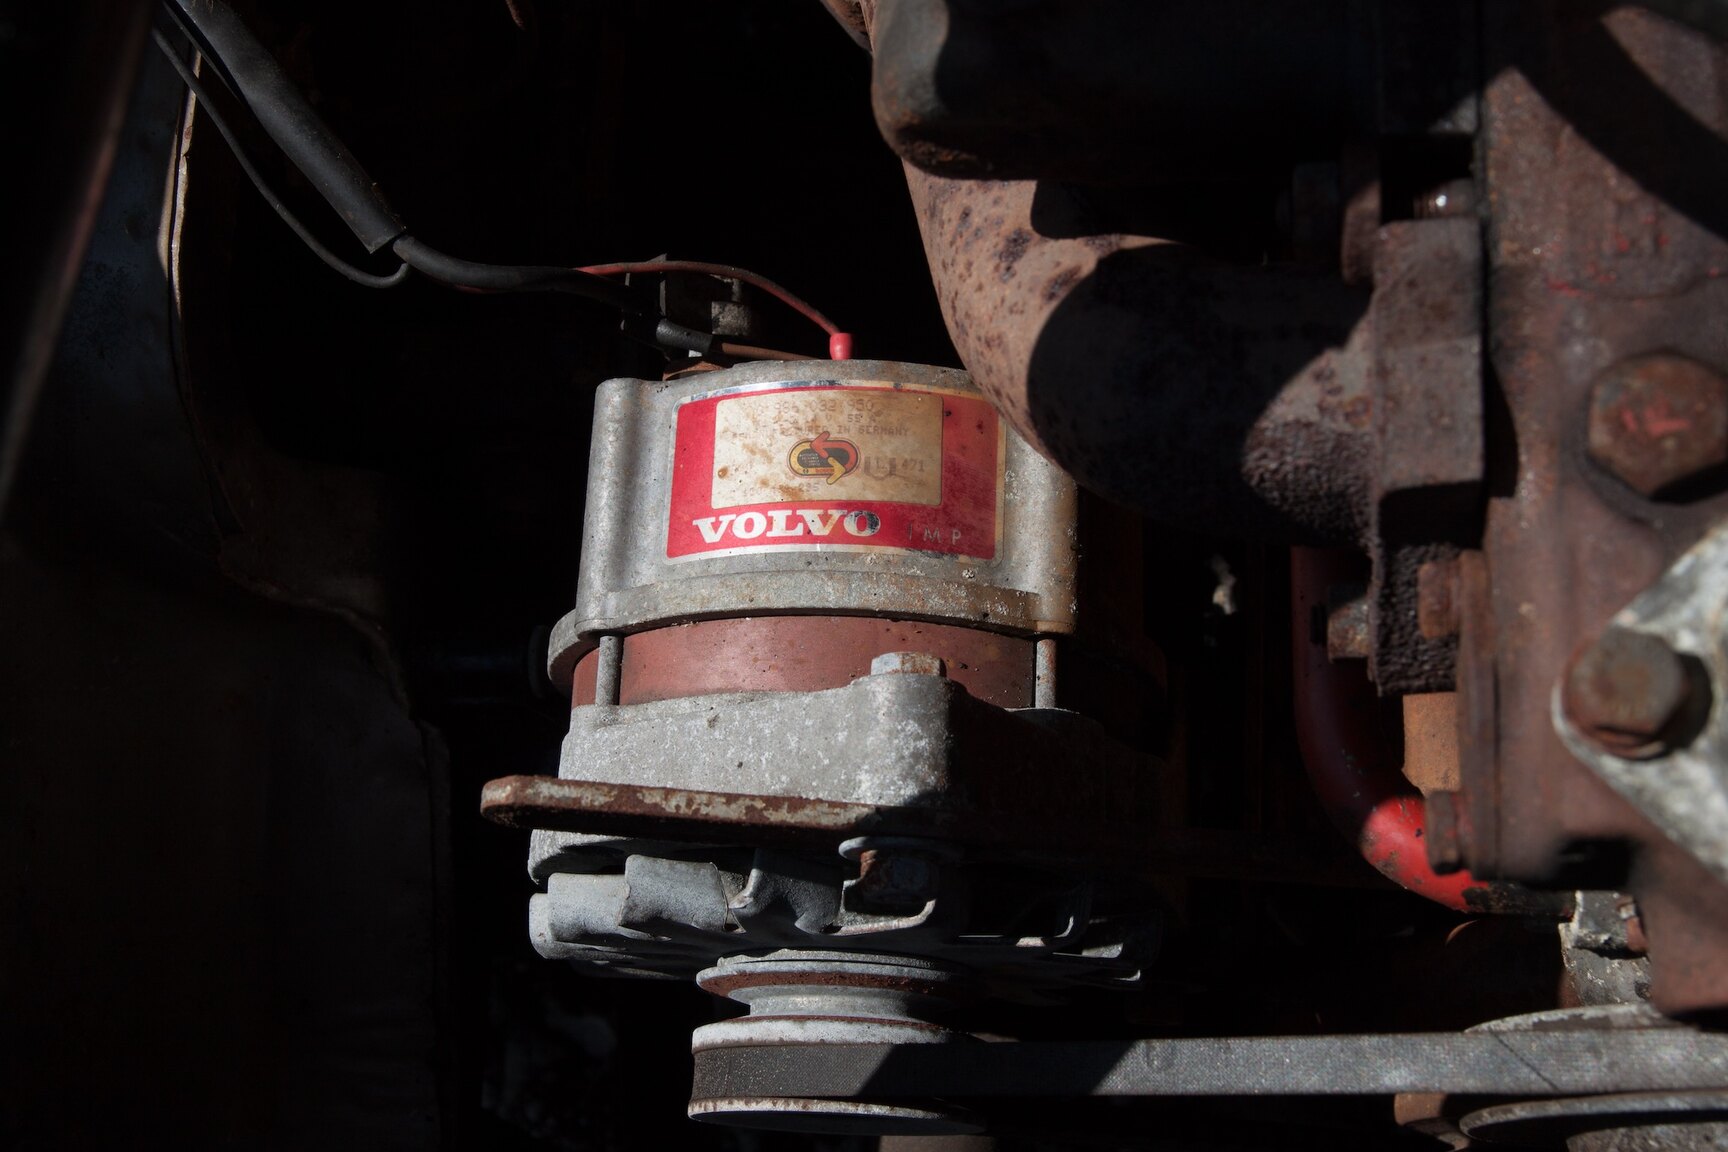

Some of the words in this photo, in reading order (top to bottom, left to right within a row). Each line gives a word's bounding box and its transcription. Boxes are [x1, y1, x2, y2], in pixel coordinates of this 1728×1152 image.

[810, 399, 837, 412] 032
[837, 425, 850, 434] IN
[858, 425, 909, 436] GERMANY
[692, 509, 881, 543] VOLVO
